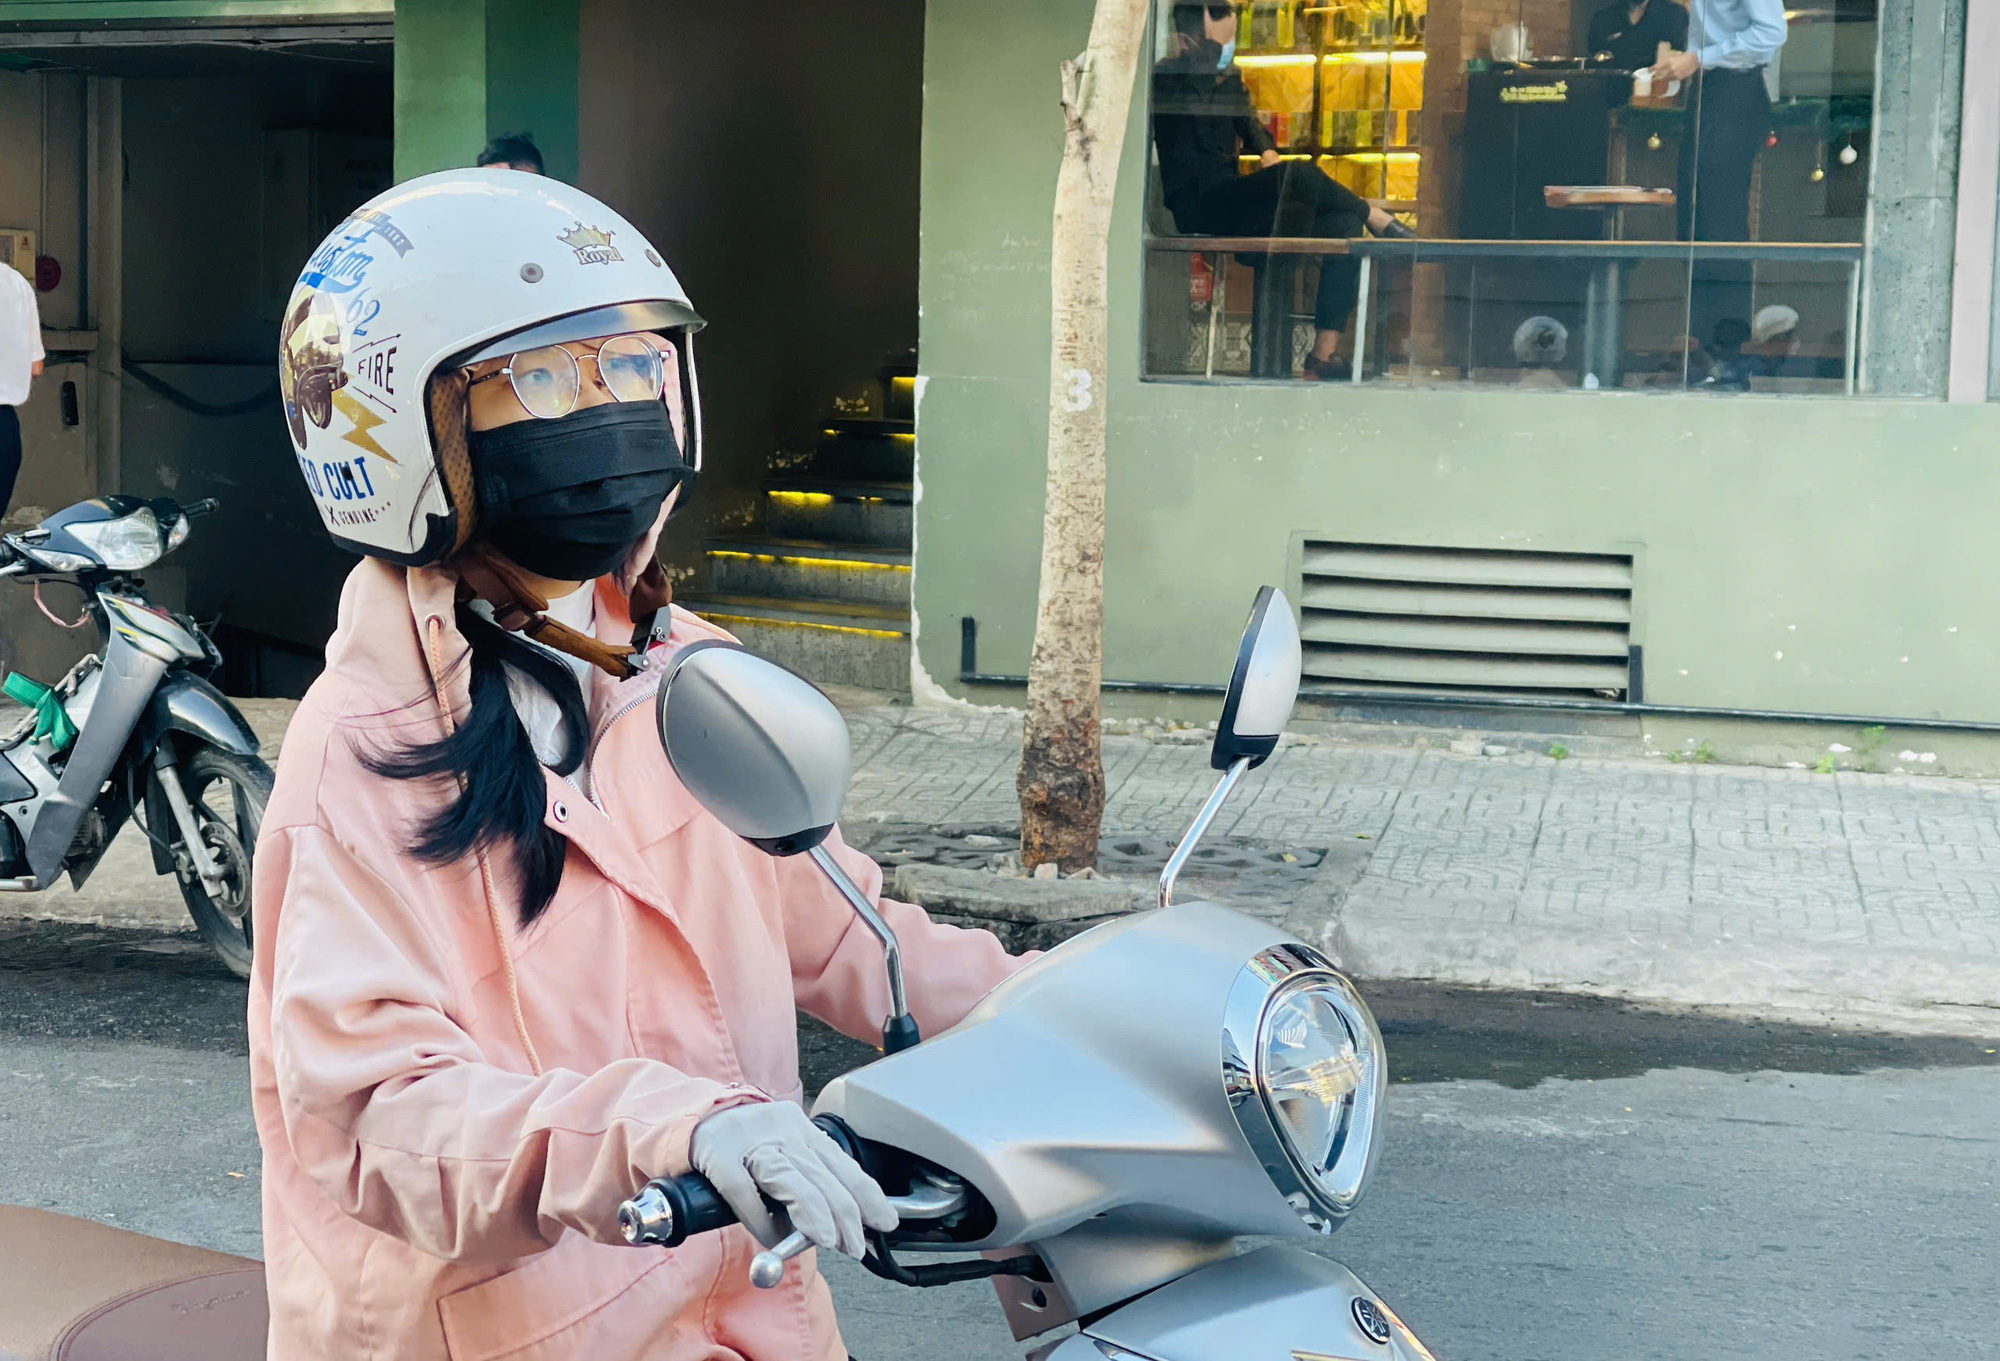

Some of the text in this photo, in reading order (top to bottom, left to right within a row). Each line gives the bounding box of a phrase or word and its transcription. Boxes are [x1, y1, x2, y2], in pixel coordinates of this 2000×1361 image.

[574, 246, 625, 265] Royal
[346, 287, 381, 337] 62
[358, 346, 398, 395] FIRE
[1062, 368, 1092, 412] 3
[323, 456, 374, 500] CULT
